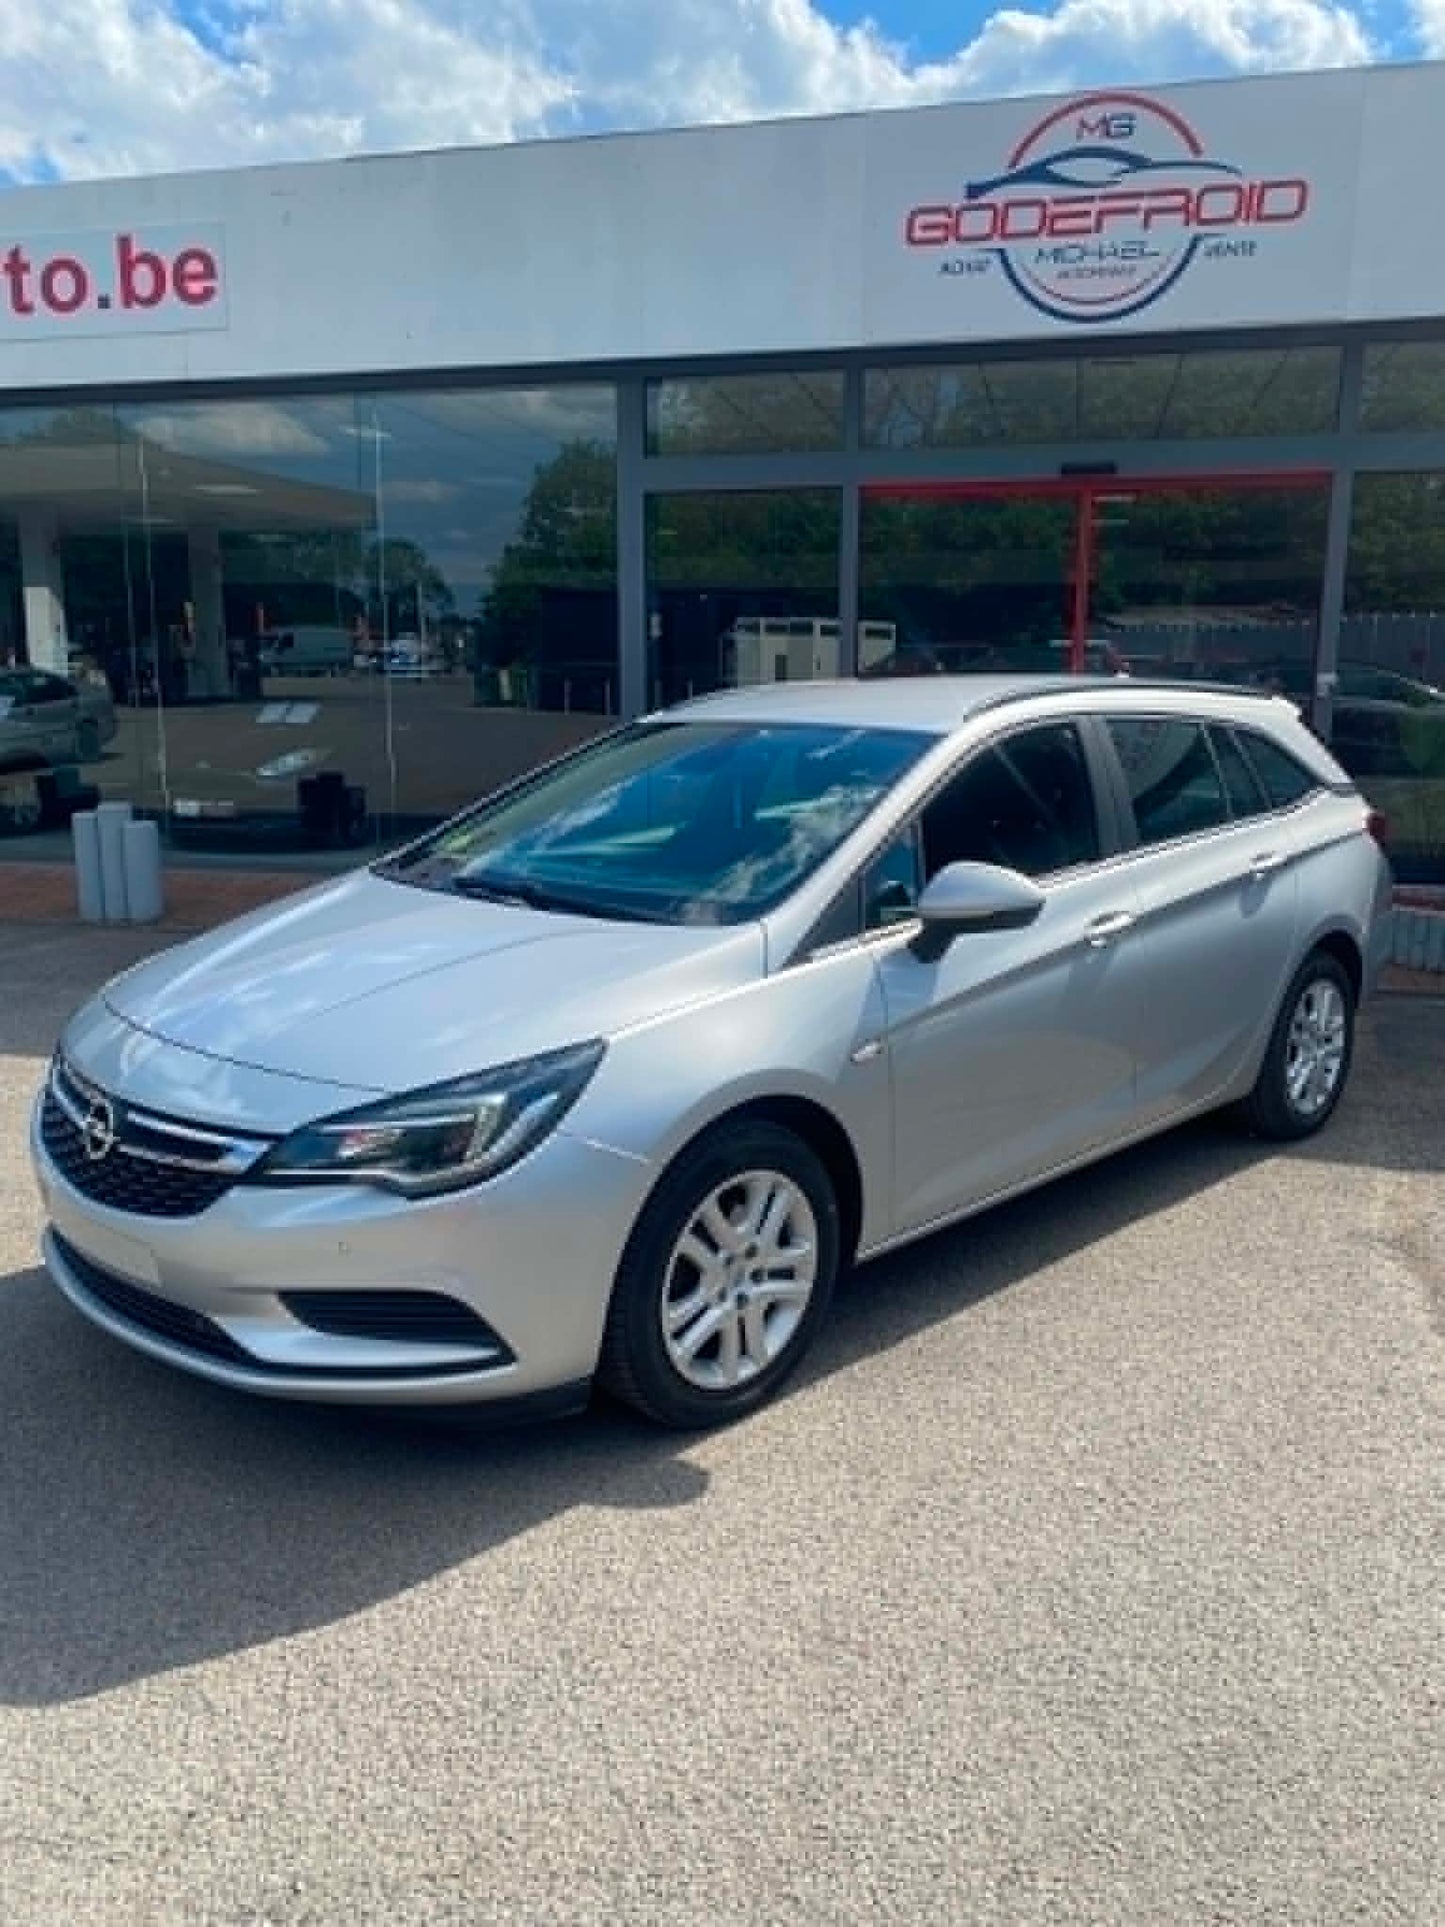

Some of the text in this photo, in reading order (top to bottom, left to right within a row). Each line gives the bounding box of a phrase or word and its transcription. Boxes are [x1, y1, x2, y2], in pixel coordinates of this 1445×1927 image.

[1076, 111, 1136, 141] MG
[906, 179, 1308, 246] GODEFROID
[3, 233, 217, 315] to.be
